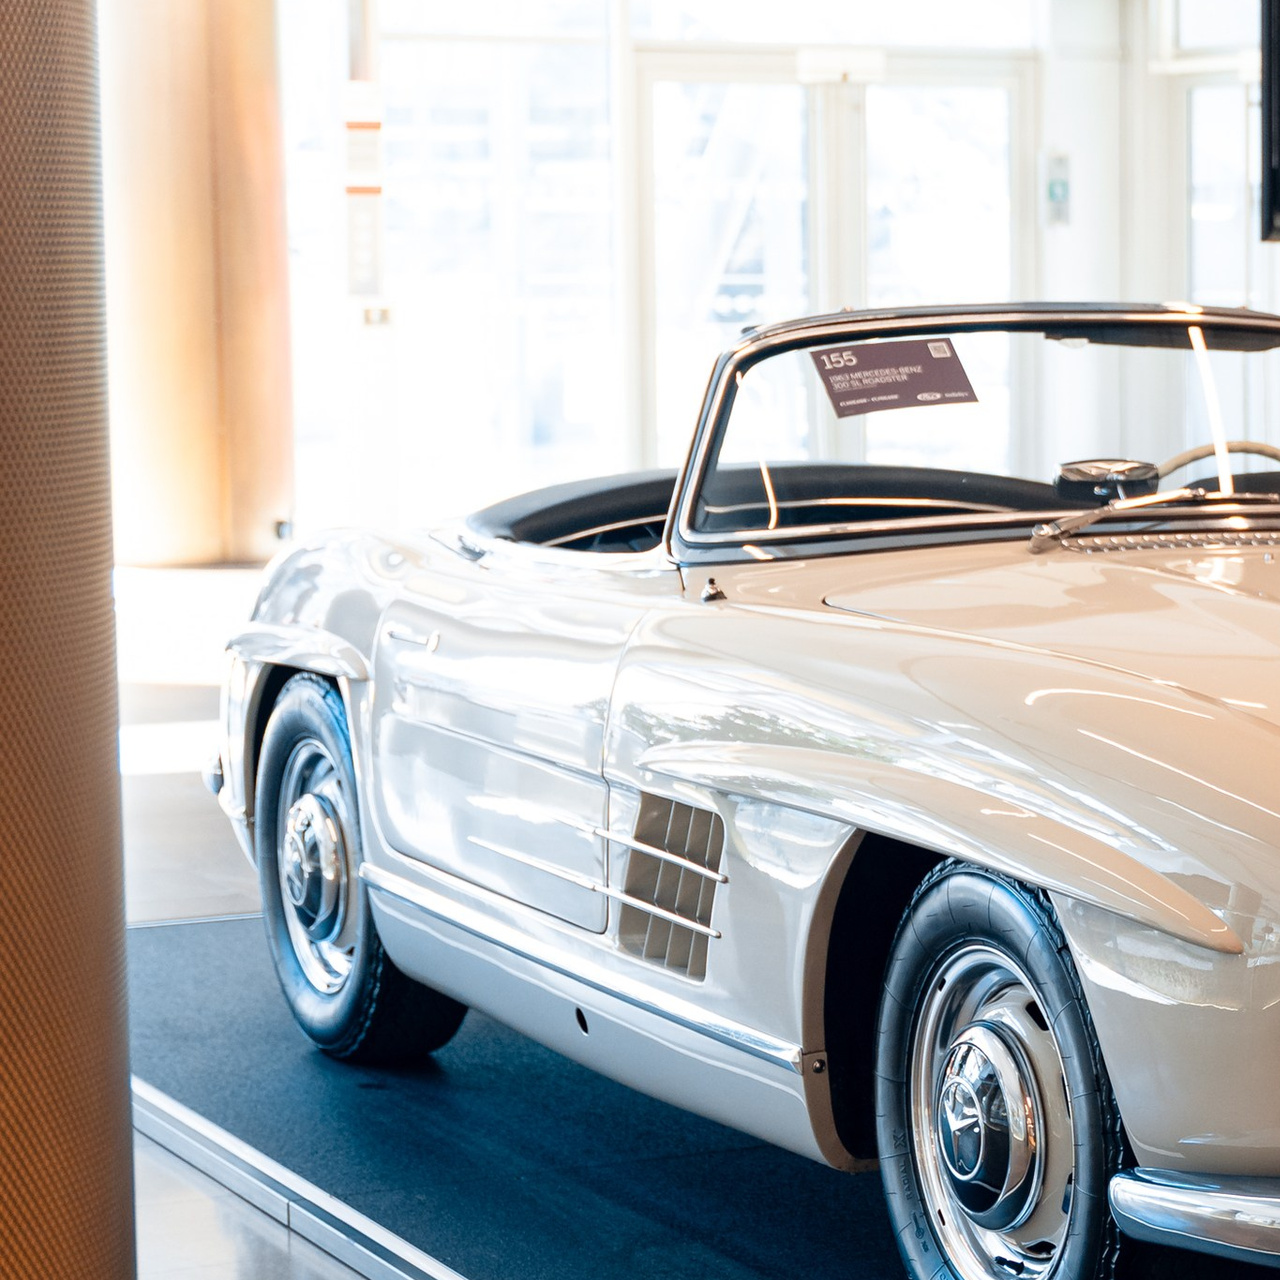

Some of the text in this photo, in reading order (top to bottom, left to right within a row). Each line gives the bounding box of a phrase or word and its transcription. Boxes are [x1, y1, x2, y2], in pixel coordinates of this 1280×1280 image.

[820, 350, 857, 370] 155
[850, 365, 922, 380] MERCEDES-BENZ
[862, 374, 908, 386] ROADSTER
